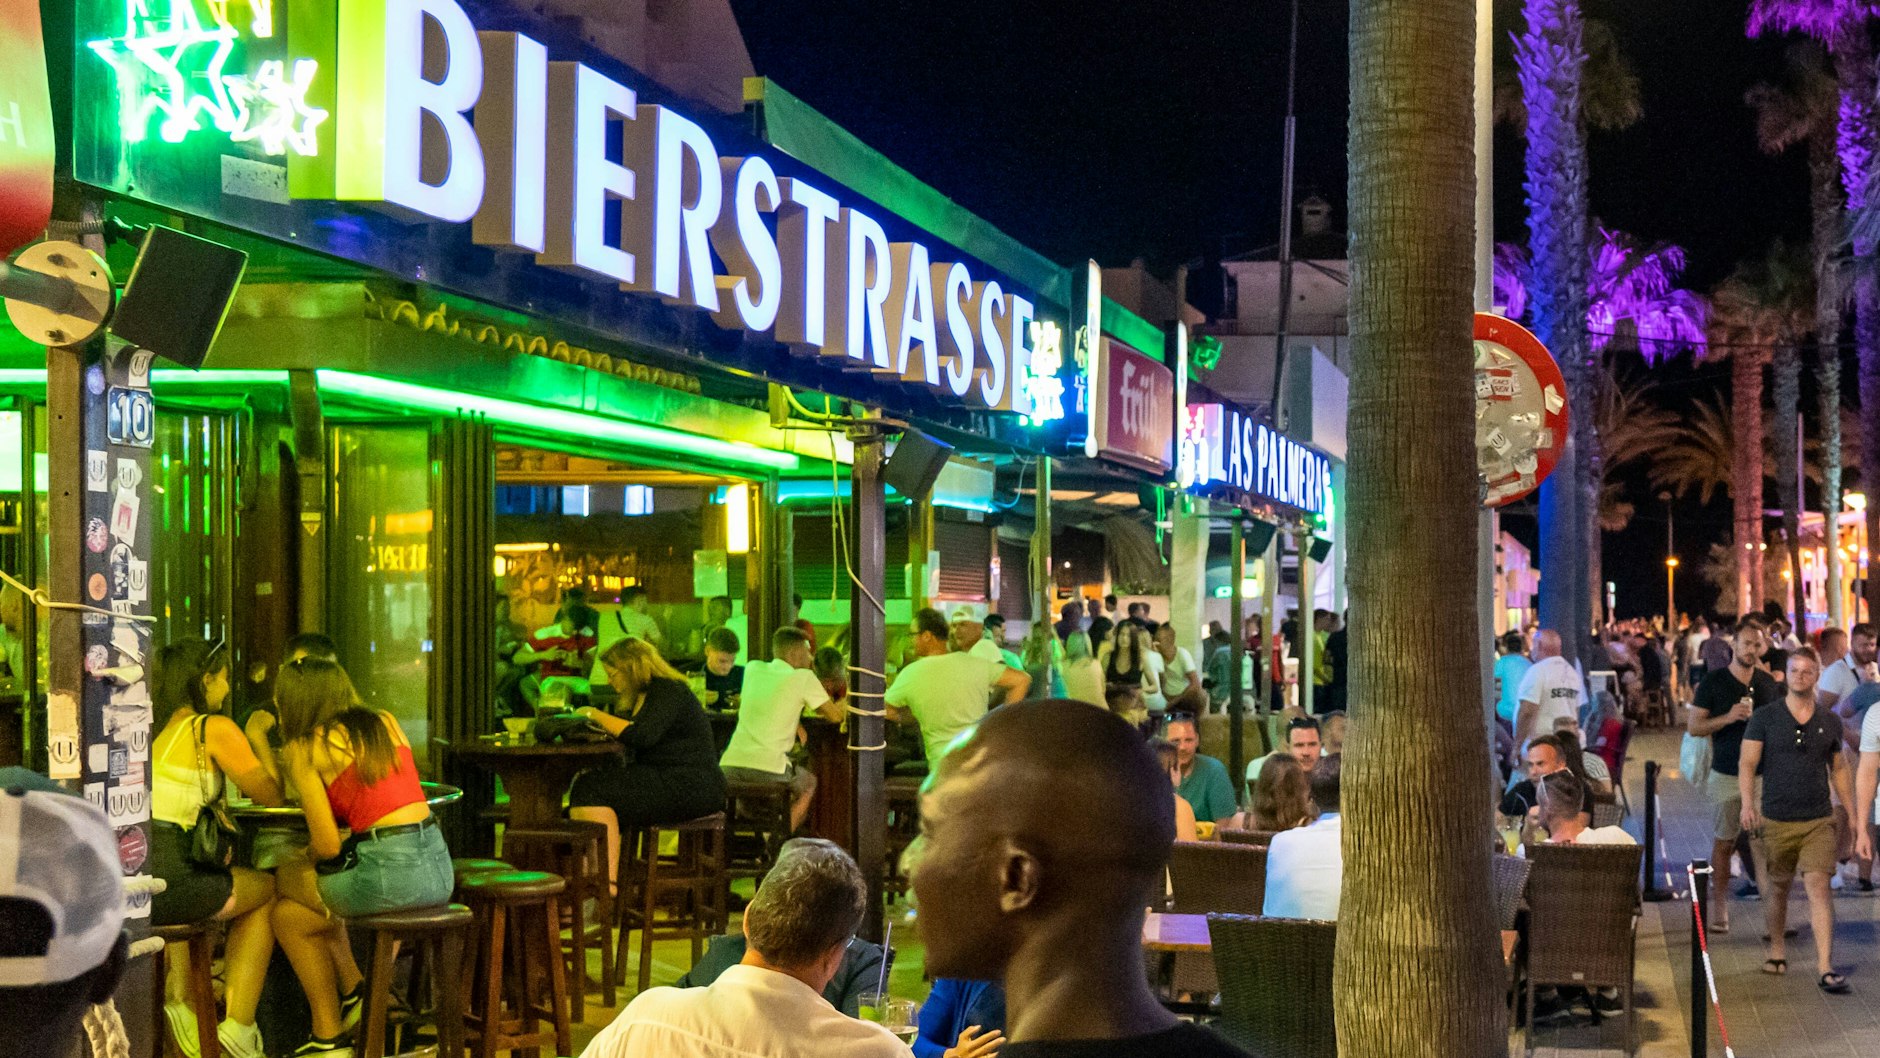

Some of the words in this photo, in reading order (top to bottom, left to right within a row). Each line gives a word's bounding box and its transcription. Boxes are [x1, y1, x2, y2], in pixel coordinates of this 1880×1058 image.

[382, 0, 1034, 415] BIERSTRASSE
[117, 393, 150, 440] 10
[1214, 403, 1254, 491] LAS
[1551, 687, 1579, 699] SETY
